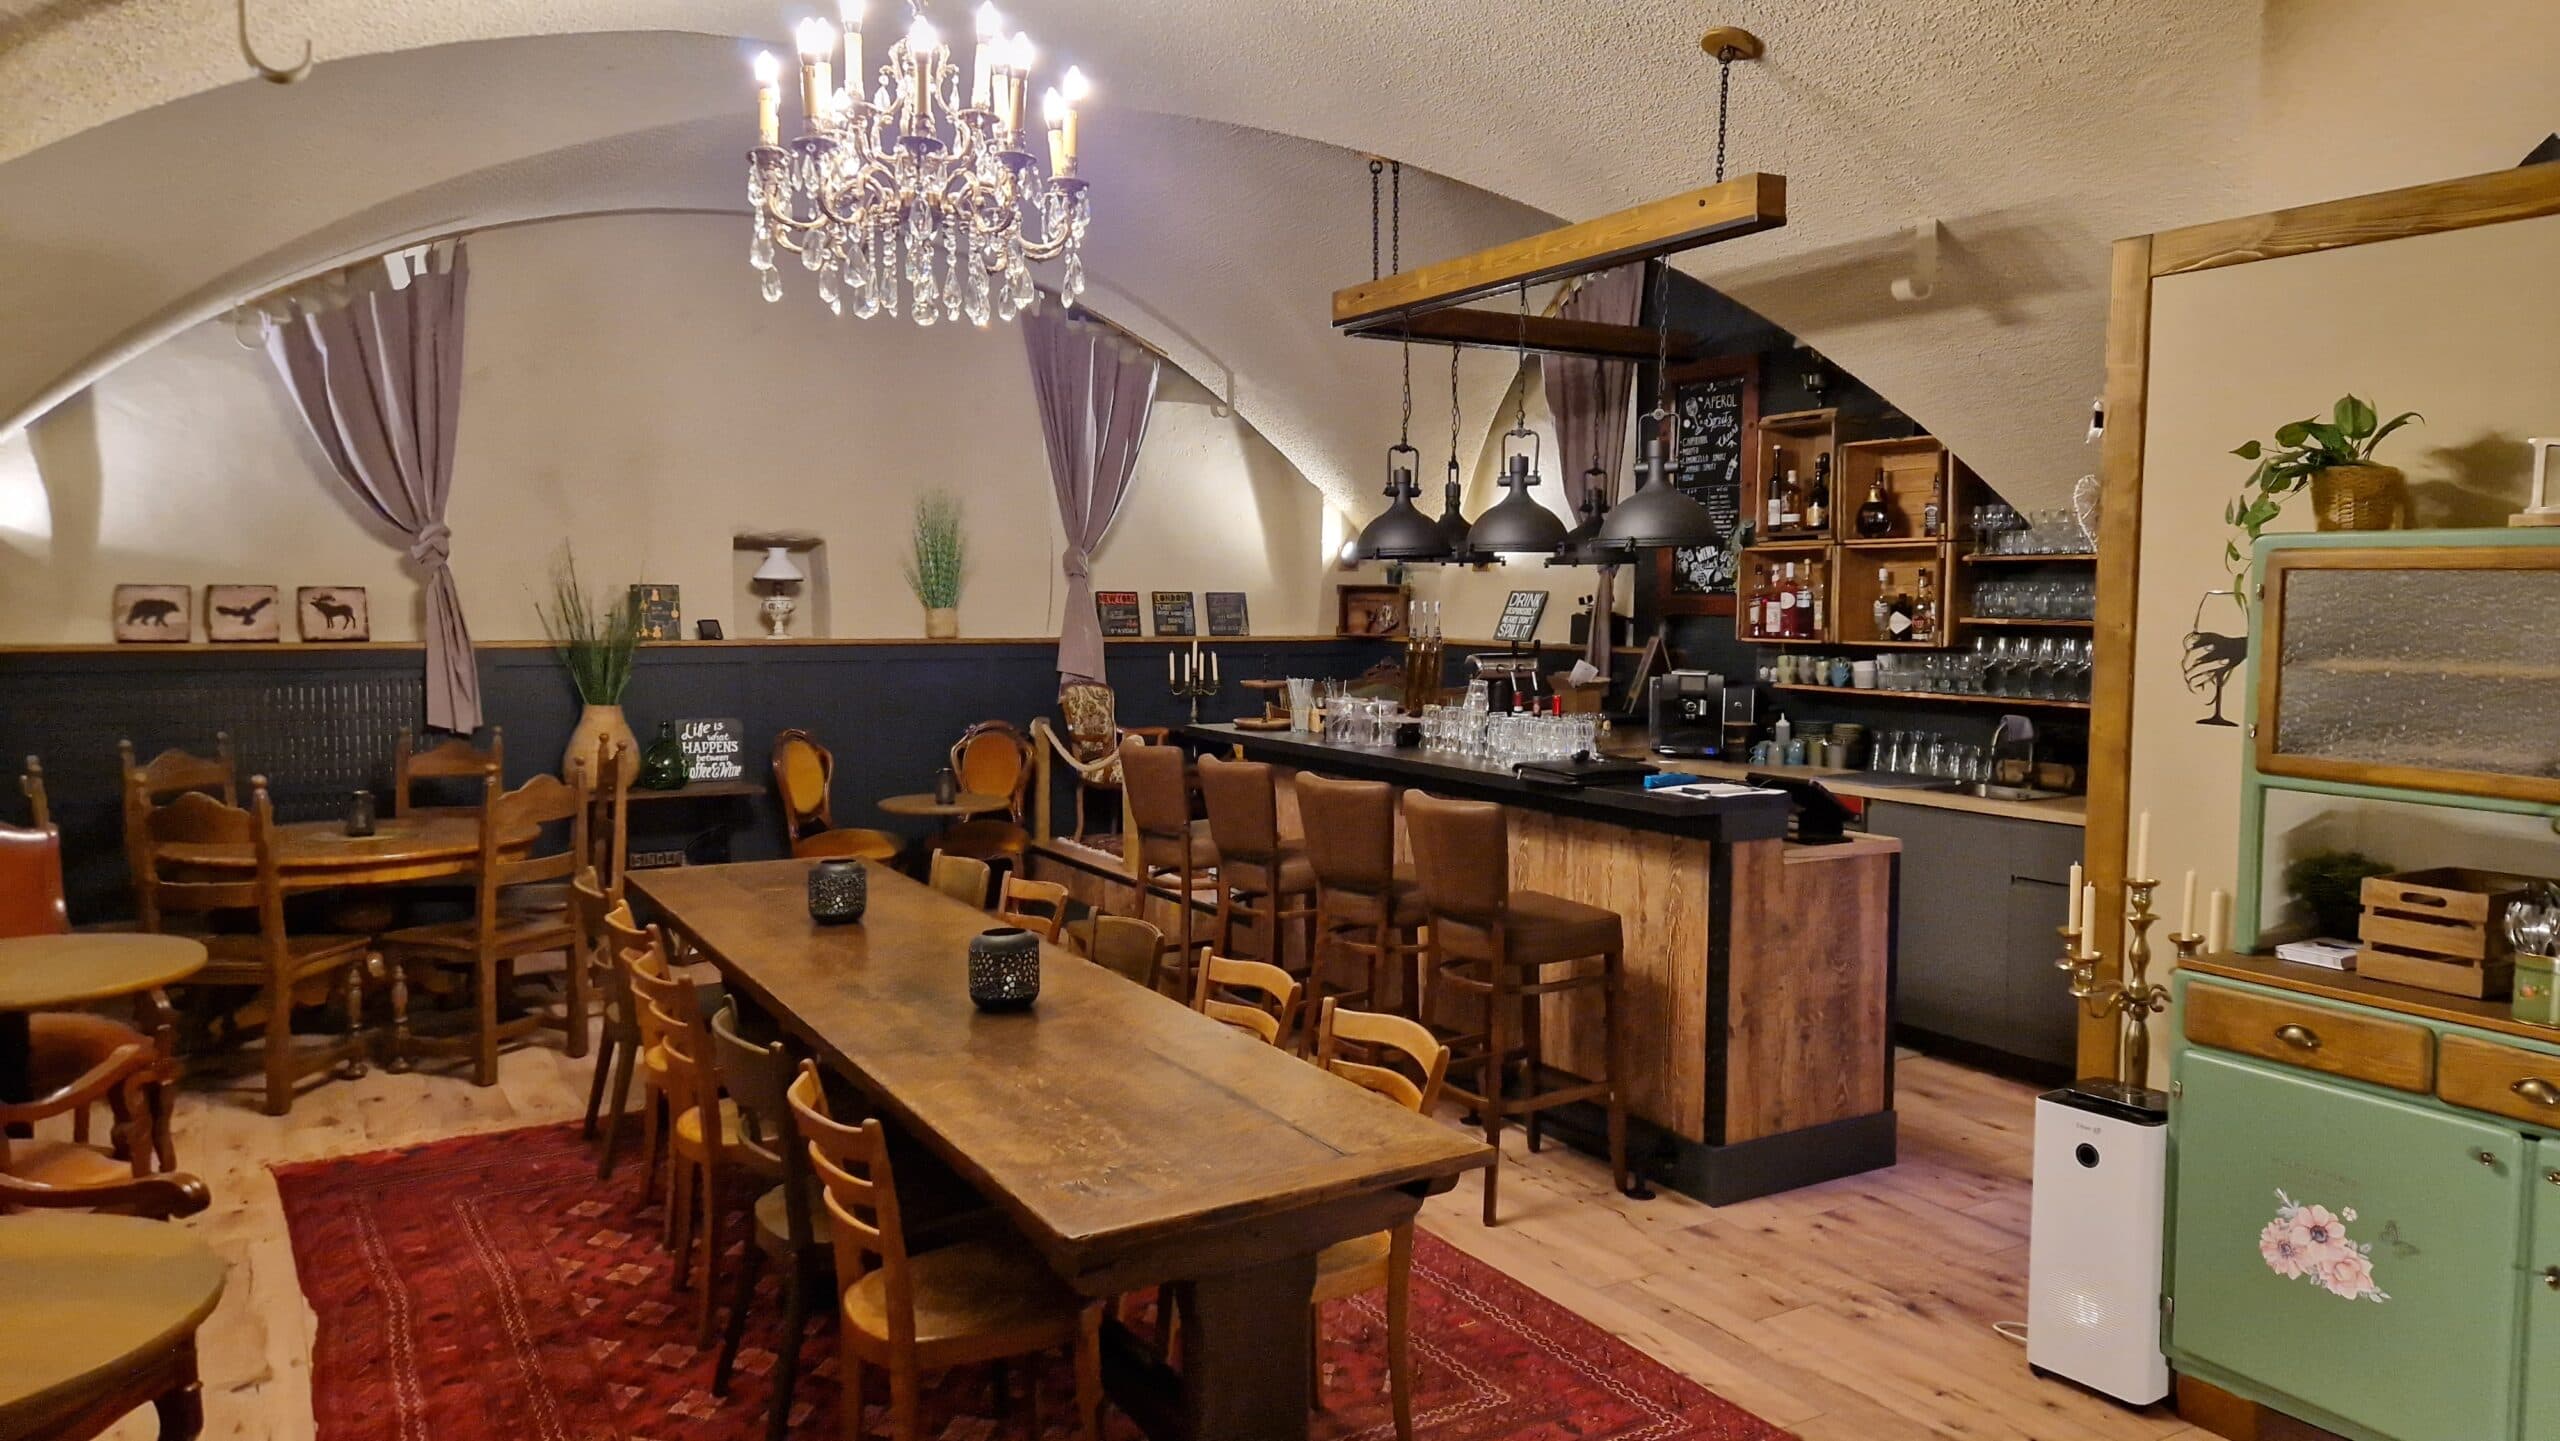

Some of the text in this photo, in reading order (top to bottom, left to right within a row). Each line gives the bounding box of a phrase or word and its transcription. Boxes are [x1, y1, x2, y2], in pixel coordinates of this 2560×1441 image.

[1703, 394, 1738, 409] APEROL
[1155, 593, 1189, 603] LONDON
[1509, 592, 1543, 607] DRINK
[1498, 623, 1531, 638] SPILL IT
[681, 721, 711, 740] Life
[707, 732, 729, 740] what
[682, 741, 738, 754] HAPPENS
